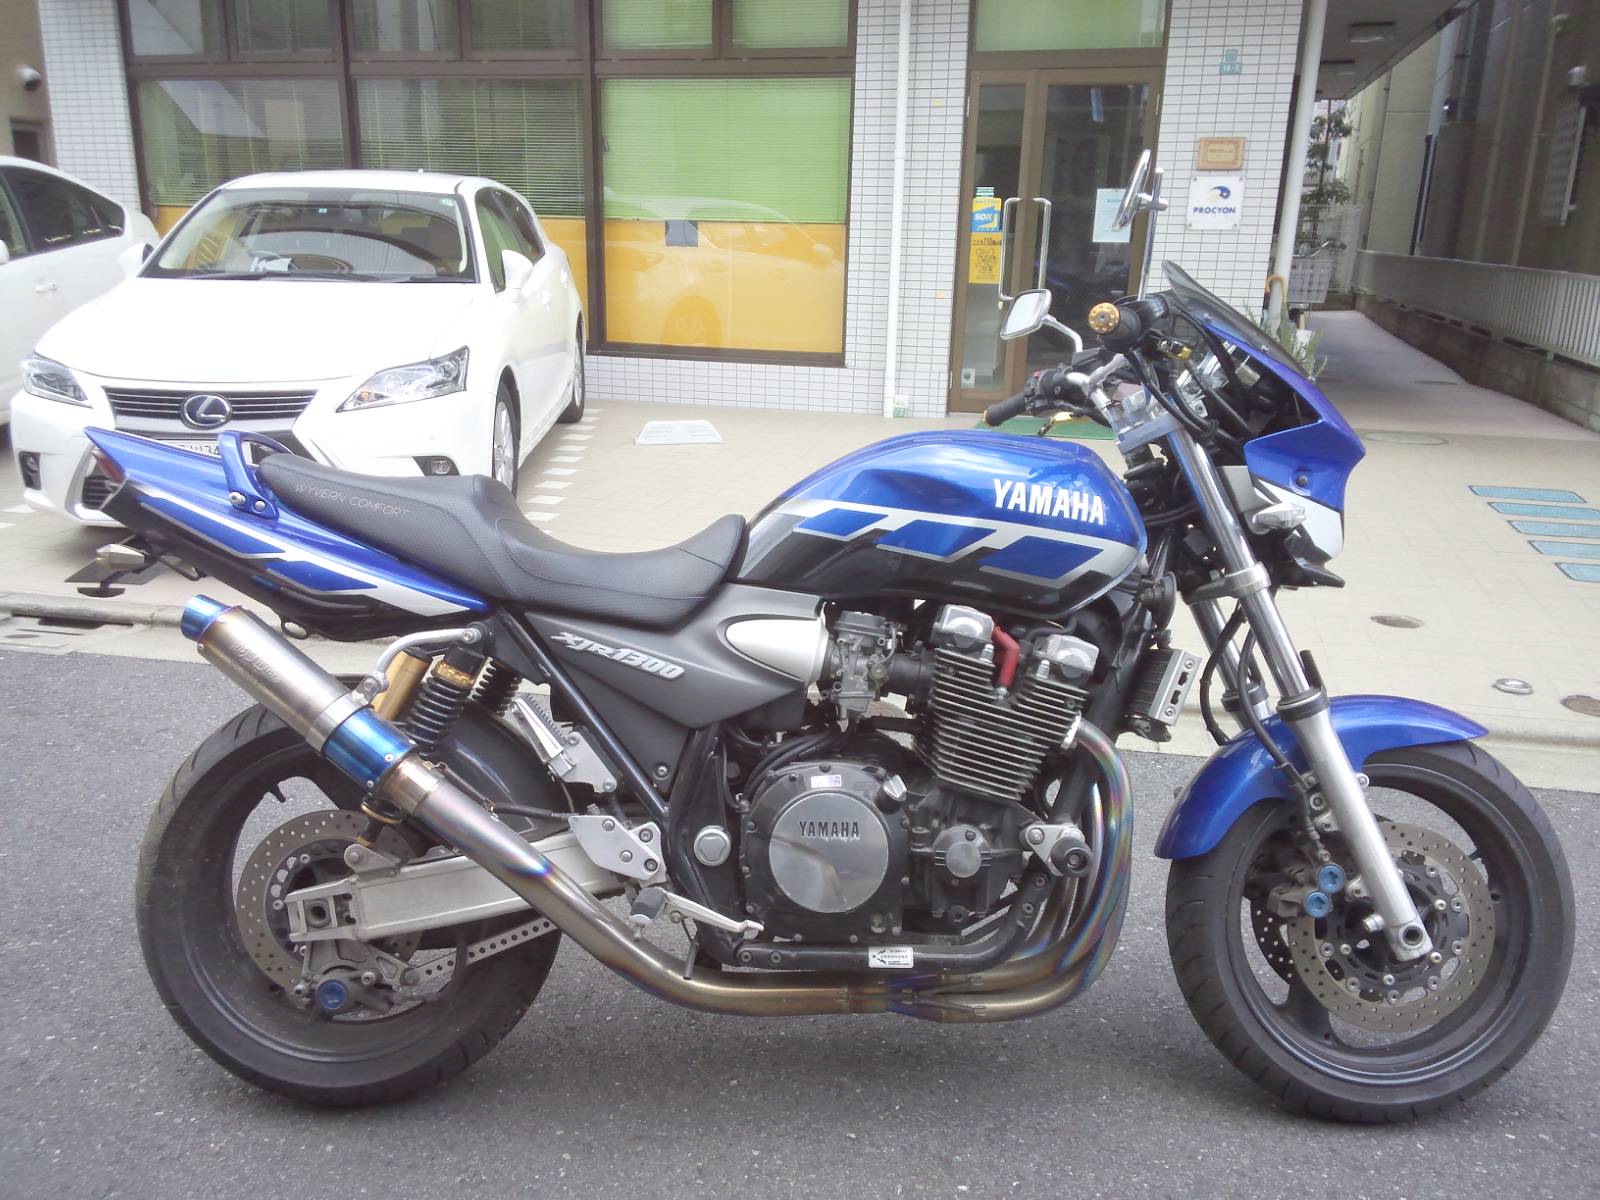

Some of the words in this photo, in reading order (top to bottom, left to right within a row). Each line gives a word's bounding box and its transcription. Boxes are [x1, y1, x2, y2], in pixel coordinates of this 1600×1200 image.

[1193, 206, 1237, 214] PROCYON
[993, 478, 1104, 526] YAMAHA
[550, 631, 686, 680] XJR1300
[799, 821, 860, 840] YAMAHA
